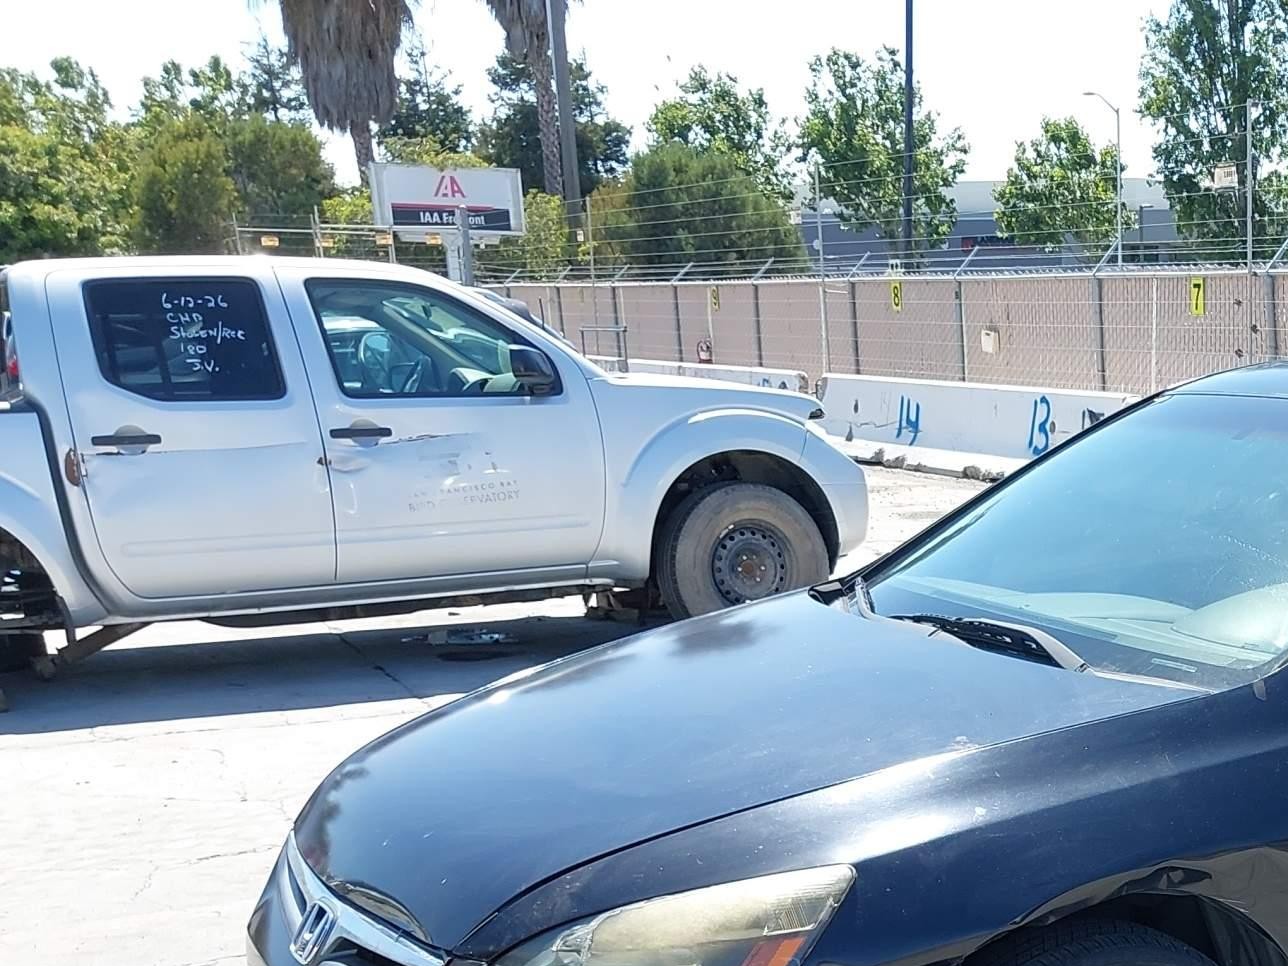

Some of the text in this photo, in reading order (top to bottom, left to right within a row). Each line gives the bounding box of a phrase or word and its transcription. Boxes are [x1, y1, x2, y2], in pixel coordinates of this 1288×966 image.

[420, 211, 440, 223] IAA
[892, 285, 900, 307] 8
[1193, 283, 1202, 311] 7
[181, 342, 207, 355] 180
[896, 395, 921, 446] 14
[1028, 395, 1051, 456] 13
